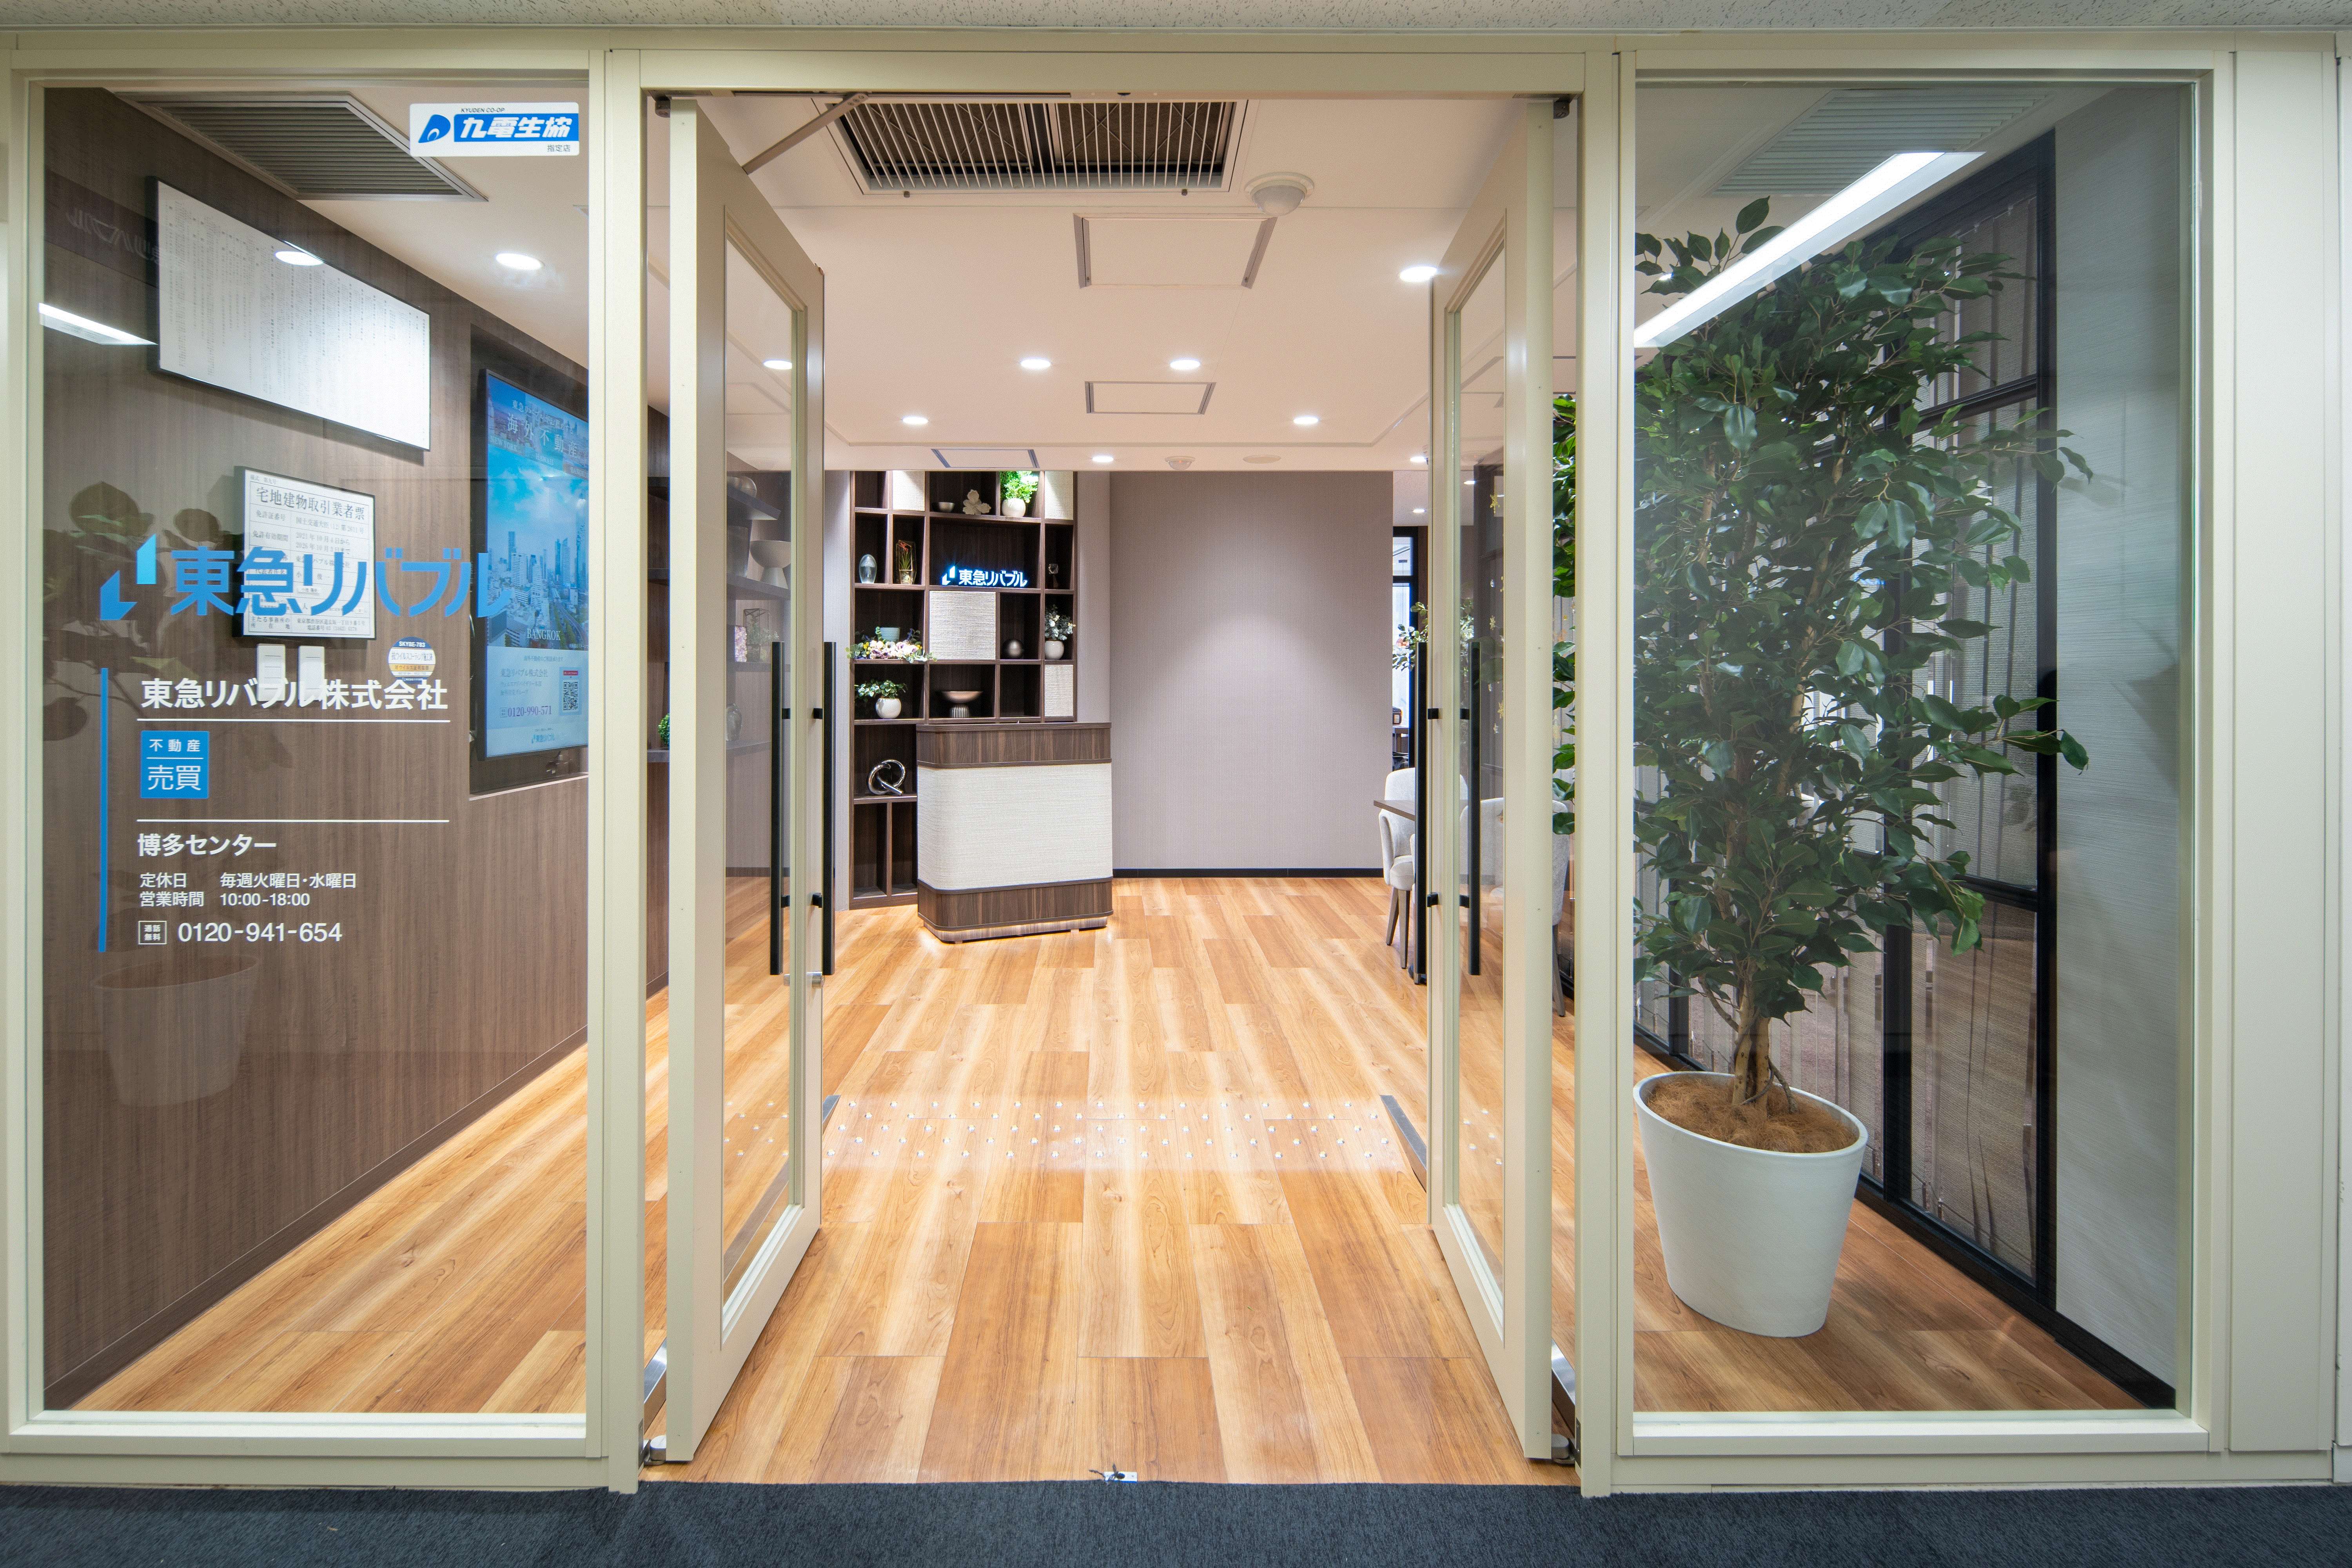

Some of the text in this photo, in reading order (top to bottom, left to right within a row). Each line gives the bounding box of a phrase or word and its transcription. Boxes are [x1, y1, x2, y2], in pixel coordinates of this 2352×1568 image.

[460, 117, 572, 138] 九電生協
[547, 144, 571, 152] 指定店
[507, 412, 578, 459] 海外不動産
[256, 486, 365, 521] 宅地建物取引業者票
[256, 510, 286, 521] 免許証番号
[171, 546, 512, 618] 東急リバブル
[959, 569, 1027, 587] 東急リバブル
[526, 628, 561, 641] BANGKOK
[501, 668, 548, 678] 東急リバブル株式会社
[141, 678, 448, 710] 東急リバブル株式会社
[508, 706, 552, 717] 0120-990-571
[149, 739, 201, 752] 不動産
[147, 765, 201, 791] 売買
[136, 833, 277, 857] 博多センター
[140, 872, 356, 889] 定休日 毎週火曜日・水曜日
[140, 891, 310, 907] 営業時間 10:00-18:00
[144, 924, 161, 933] 通話
[144, 933, 161, 941] 無料
[178, 922, 342, 942] 0120-941-654
